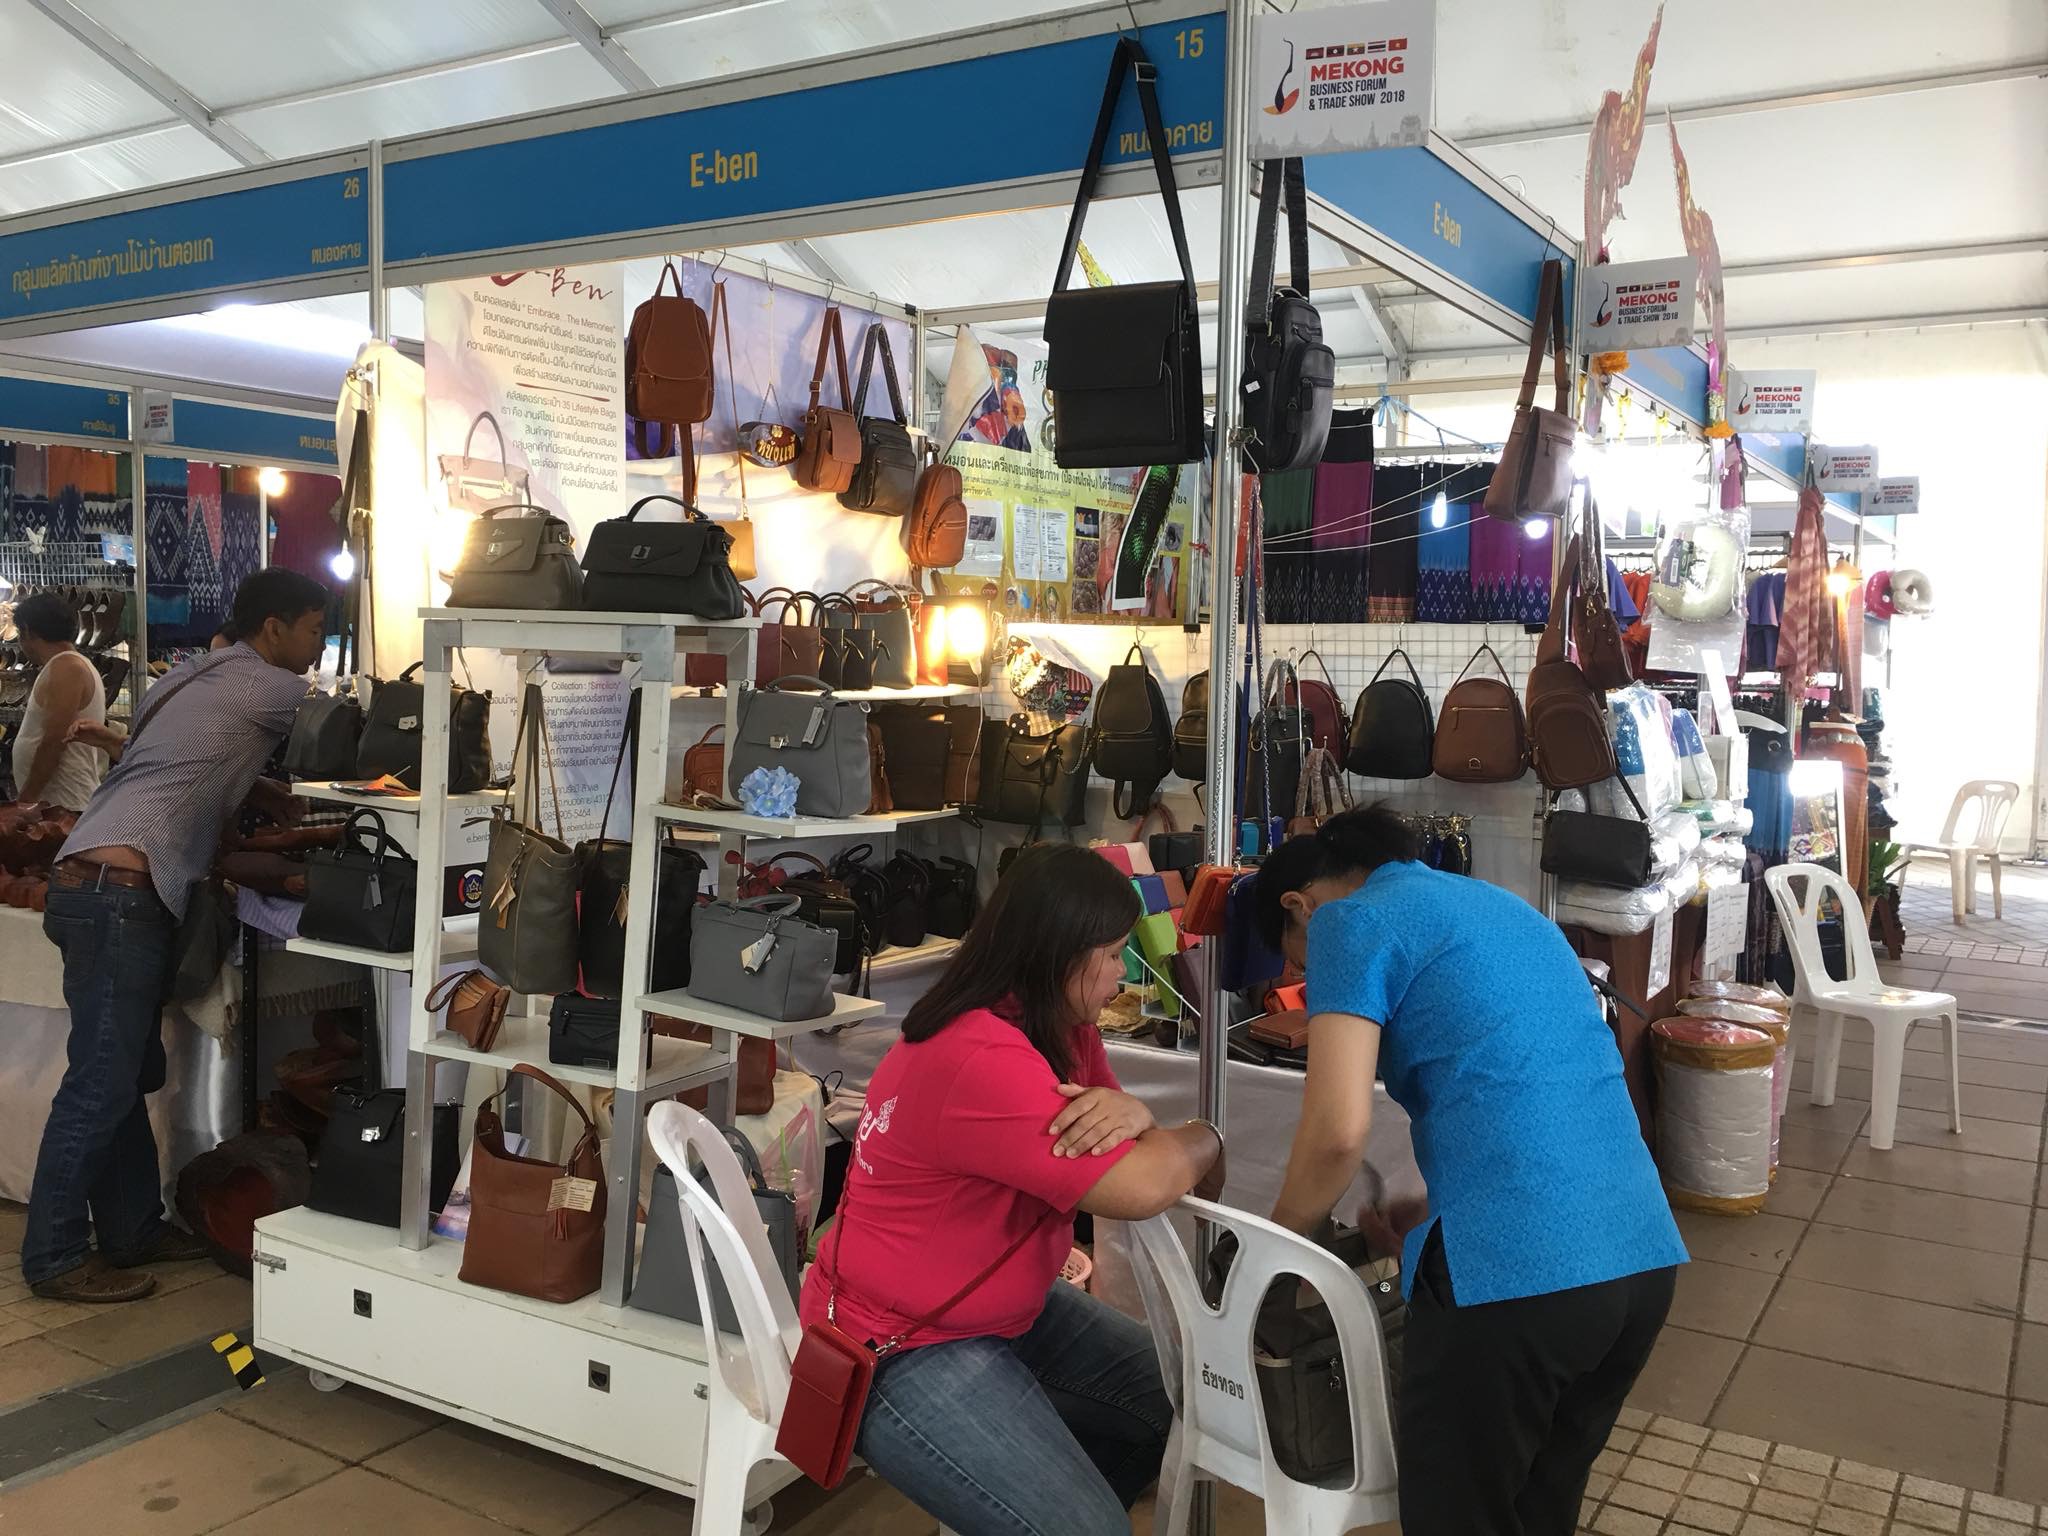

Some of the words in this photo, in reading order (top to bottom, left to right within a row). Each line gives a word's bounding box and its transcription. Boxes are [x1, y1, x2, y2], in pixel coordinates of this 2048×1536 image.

[1175, 28, 1204, 59] 15
[1310, 56, 1404, 82] MEKONG
[1310, 81, 1353, 97] BUSINESS
[1355, 77, 1387, 92] FORUM
[1308, 98, 1315, 111] &
[1318, 96, 1347, 110] TRADE
[1349, 93, 1376, 107] SHOW
[1380, 89, 1405, 104] 2018
[1119, 120, 1213, 156] หนงคาย
[690, 149, 758, 188] E-ben
[343, 177, 360, 198] 26
[1433, 200, 1462, 249] E-ben
[311, 243, 361, 265] หนองคาย
[1618, 291, 1679, 308] MEKONG
[1618, 306, 1646, 316] BUSINESS
[1647, 304, 1667, 313] FORUM
[1623, 315, 1641, 324] TRADE
[1643, 313, 1660, 322] SHOW
[1662, 312, 1679, 321] 2018
[1755, 394, 1801, 402] MEKONG
